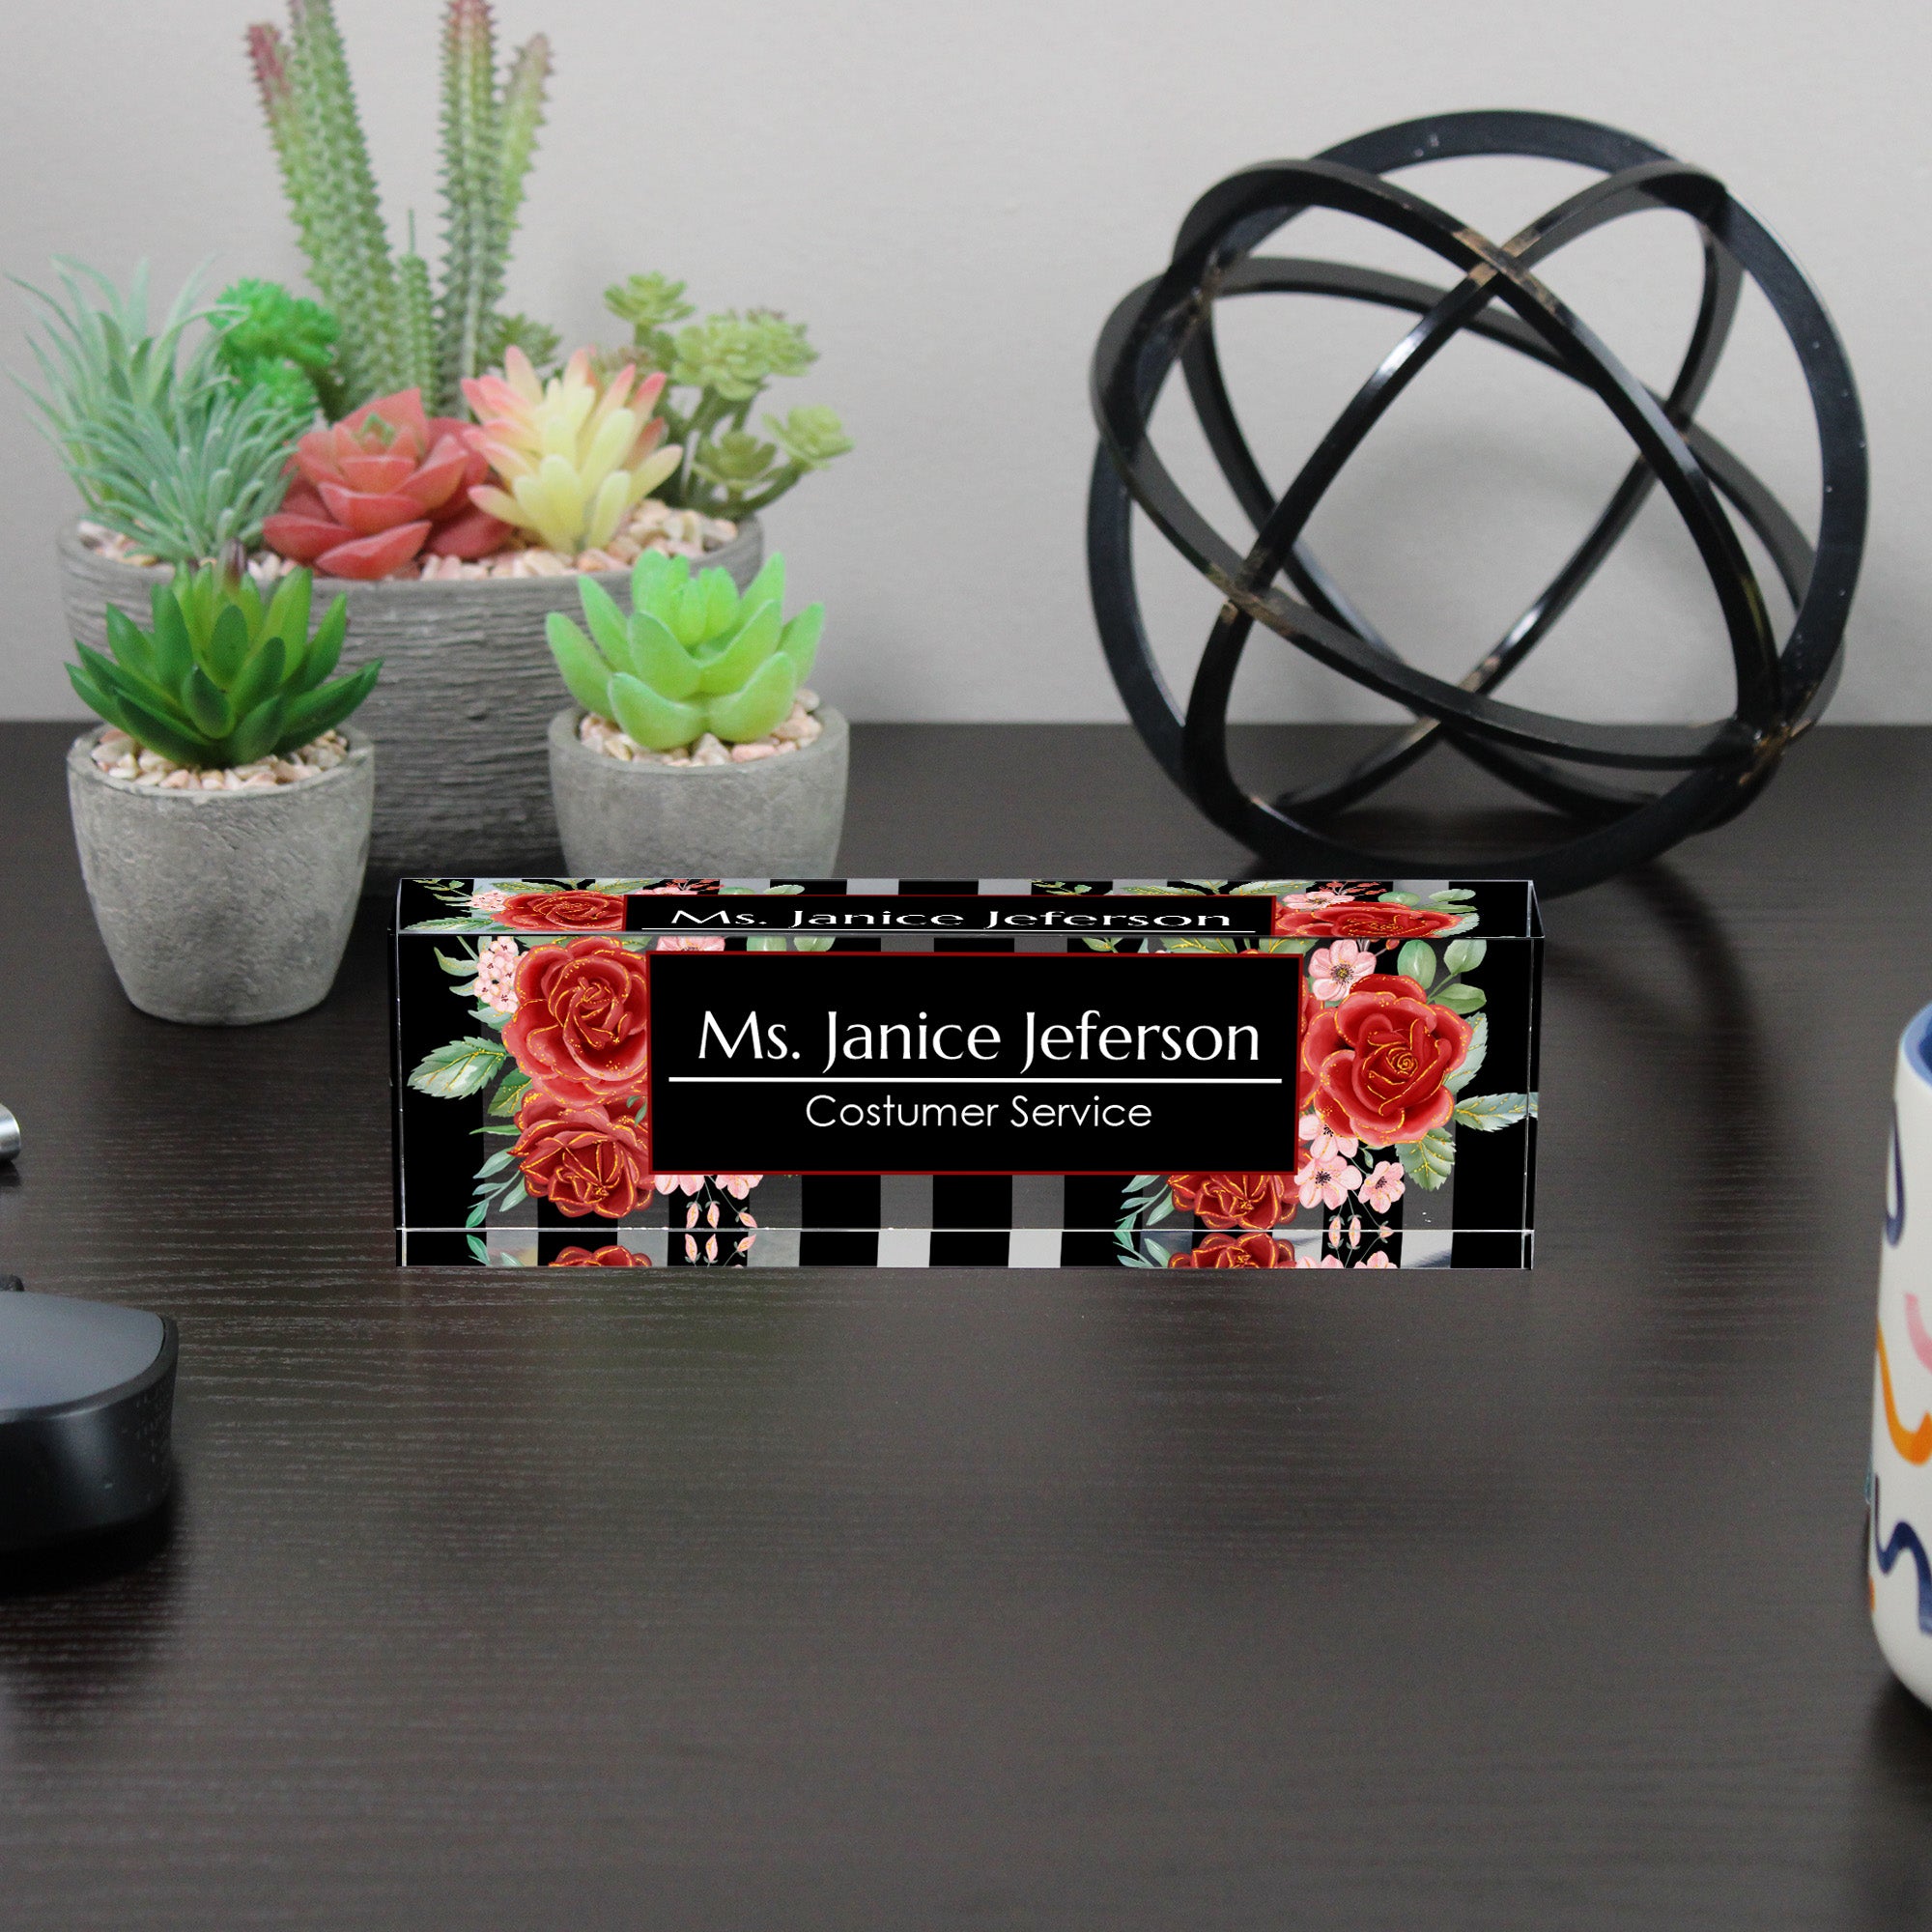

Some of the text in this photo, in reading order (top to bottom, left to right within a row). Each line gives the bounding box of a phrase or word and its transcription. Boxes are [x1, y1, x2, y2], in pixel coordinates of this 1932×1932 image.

[671, 910, 1230, 928] Ms. Janice Jeferson
[697, 1009, 1259, 1074] Ms. Janice Jeferson
[806, 1094, 1152, 1128] Costumer Service
